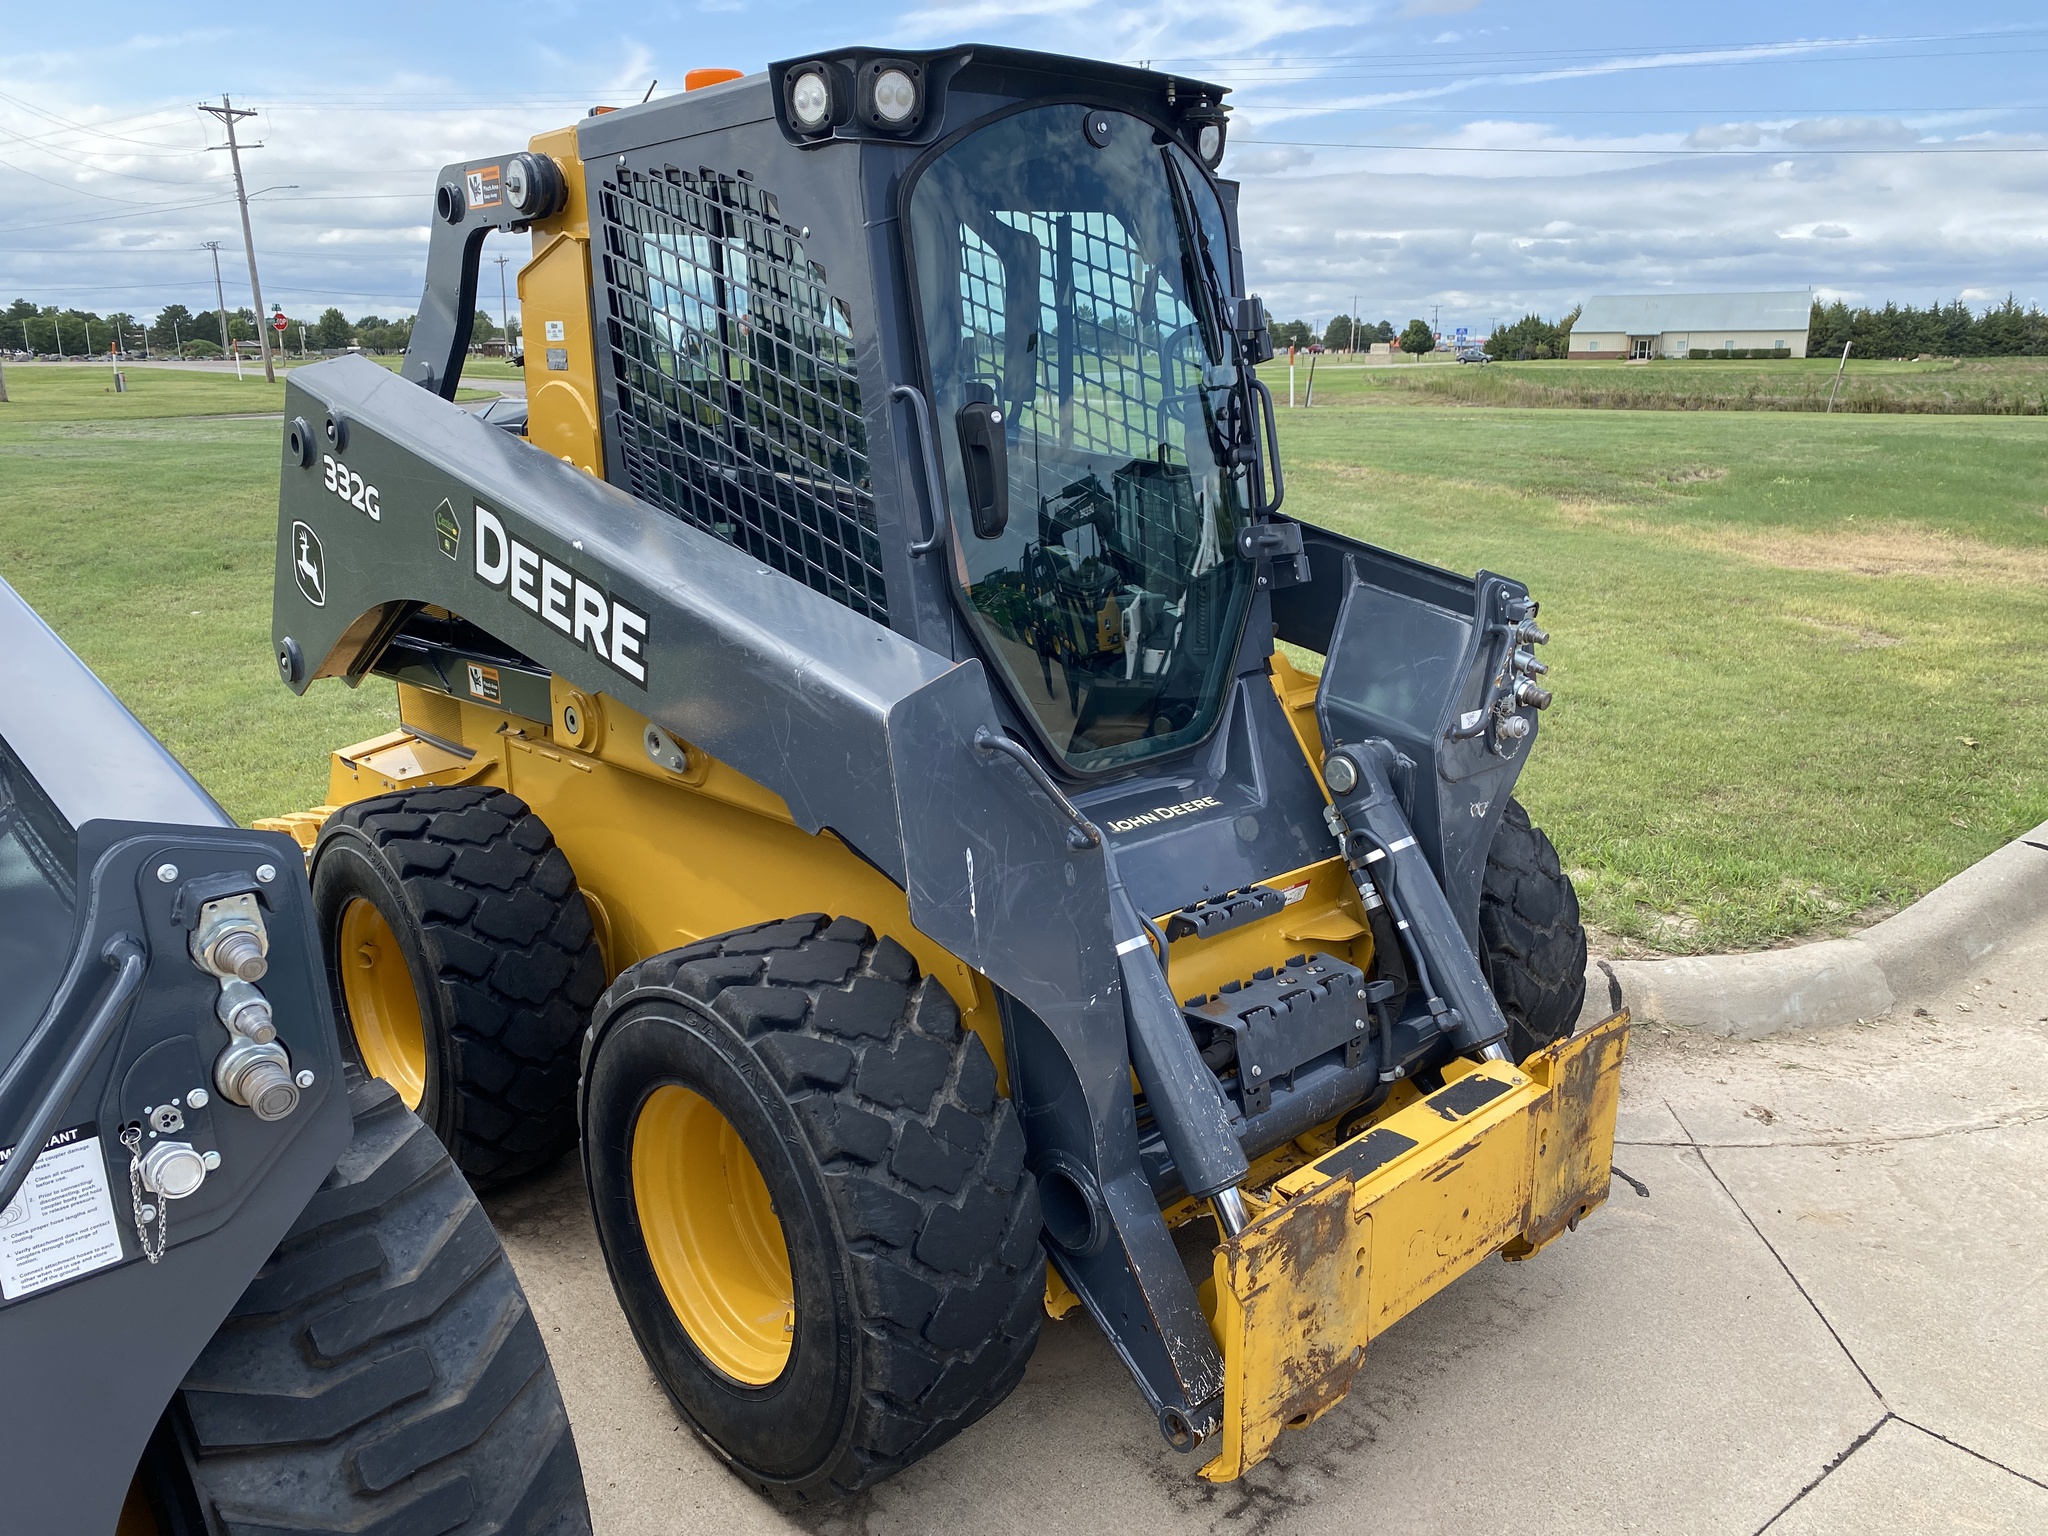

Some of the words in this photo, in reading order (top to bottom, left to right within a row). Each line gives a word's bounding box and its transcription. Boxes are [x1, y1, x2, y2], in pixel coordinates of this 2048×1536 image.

[323, 454, 380, 522] 332G
[475, 504, 647, 682] DEERE
[1107, 813, 1161, 833] JOHN
[1154, 796, 1221, 820] DEERE
[684, 1009, 800, 1146] GALAXY
[45, 1151, 66, 1161] coupler
[67, 1145, 89, 1154] damage
[60, 1165, 84, 1175] couplers
[36, 1180, 54, 1188] before
[60, 1178, 93, 1193] connecting/
[81, 1184, 96, 1192] push
[41, 1201, 62, 1211] coupler
[90, 1187, 102, 1195] hold
[49, 1205, 69, 1214] release
[70, 1196, 96, 1208] pressure.
[11, 1230, 29, 1238] Check
[30, 1223, 49, 1233] proper
[50, 1218, 64, 1226] hose
[65, 1211, 86, 1220] lengths
[12, 1235, 34, 1244] routing.
[14, 1247, 31, 1255] Verify
[32, 1236, 64, 1250] attachment
[90, 1220, 110, 1230] contact
[16, 1250, 41, 1261] couplers
[41, 1242, 64, 1253] through
[75, 1233, 91, 1241] range
[17, 1258, 38, 1267] motion.
[19, 1267, 43, 1278] Connect
[45, 1256, 76, 1270] attachment
[76, 1250, 93, 1258] hoses
[20, 1276, 35, 1284] other
[37, 1270, 52, 1278] when
[21, 1281, 39, 1290] hoses
[59, 1266, 80, 1277] ground.
